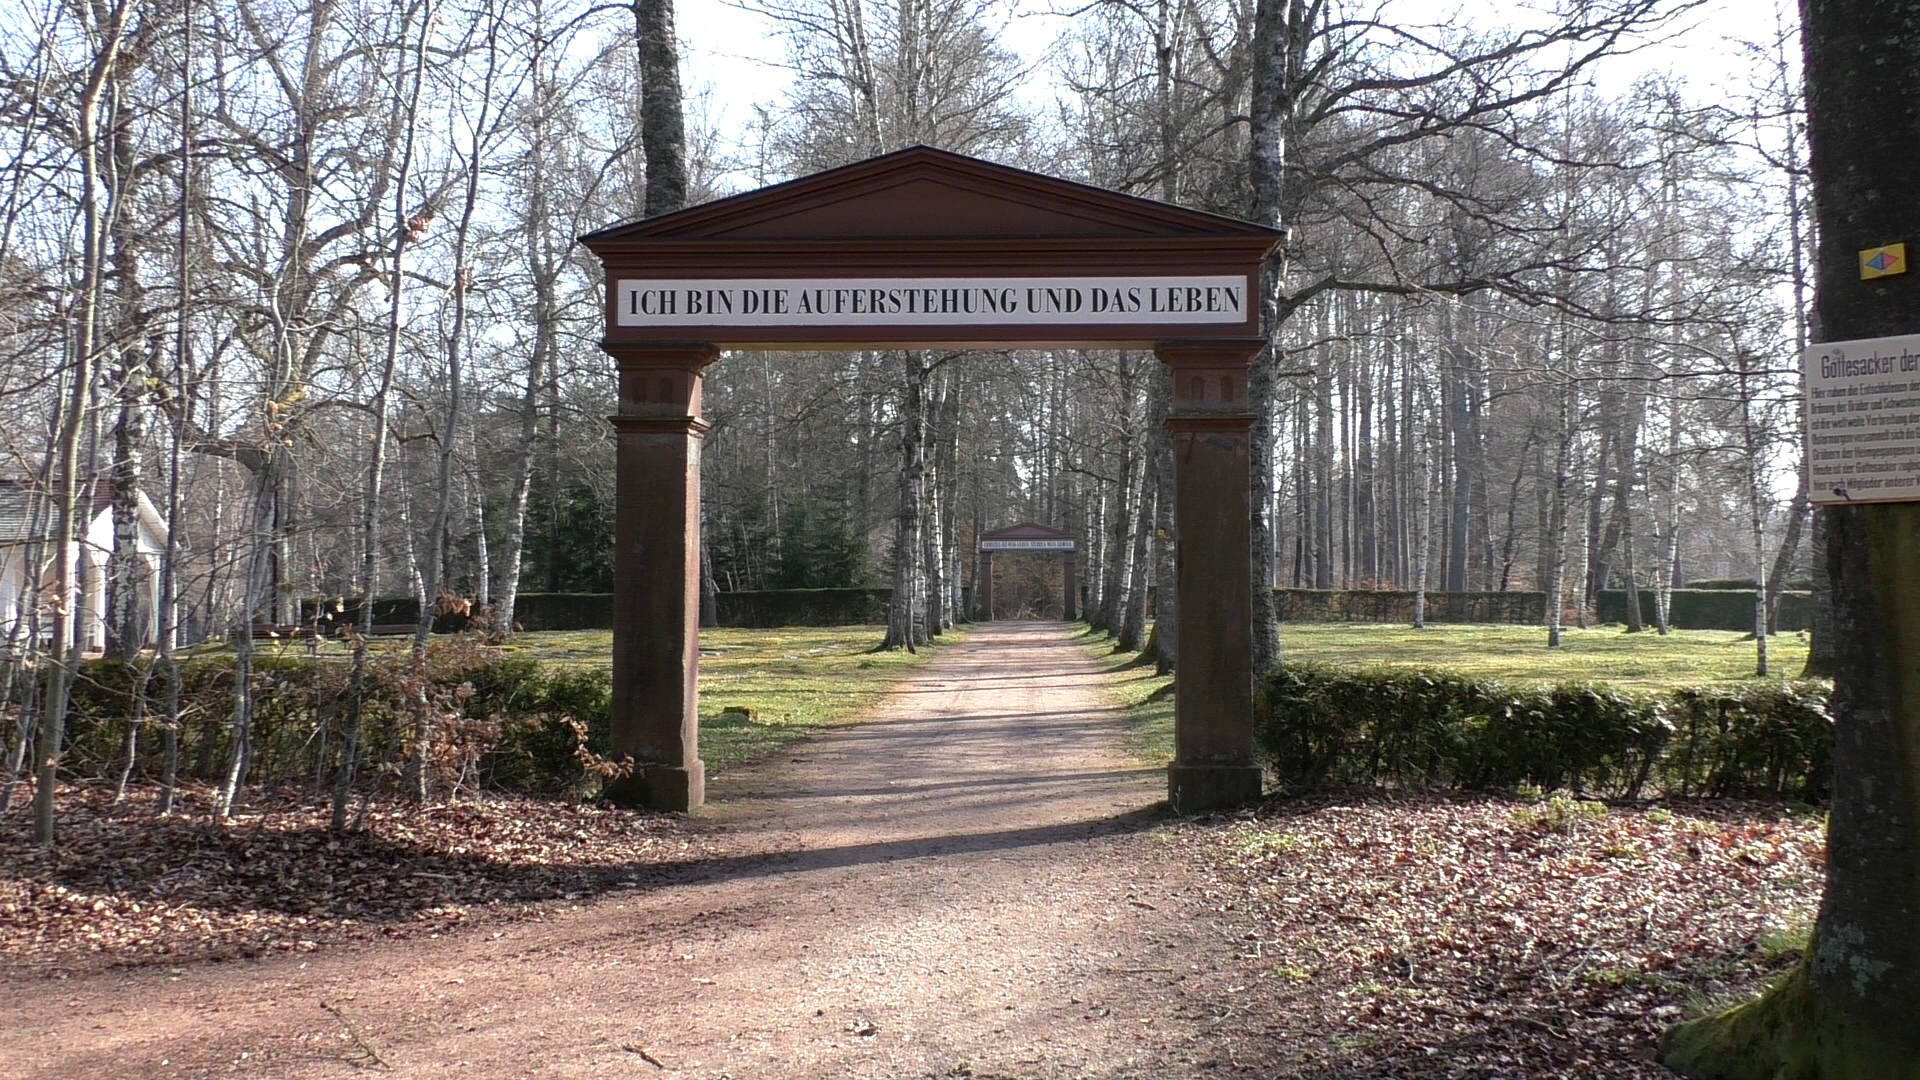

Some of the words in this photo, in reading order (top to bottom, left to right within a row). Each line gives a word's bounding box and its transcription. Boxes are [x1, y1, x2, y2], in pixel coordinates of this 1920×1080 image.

[629, 290, 678, 315] ICH
[685, 289, 733, 315] BIN
[741, 289, 789, 315] DIE
[796, 287, 1018, 315] AUFERSTEHUNG
[1026, 287, 1082, 314] UND
[1090, 287, 1141, 313] DAS
[1149, 286, 1241, 313] LEBEN
[1821, 350, 1897, 379] Gottesacker
